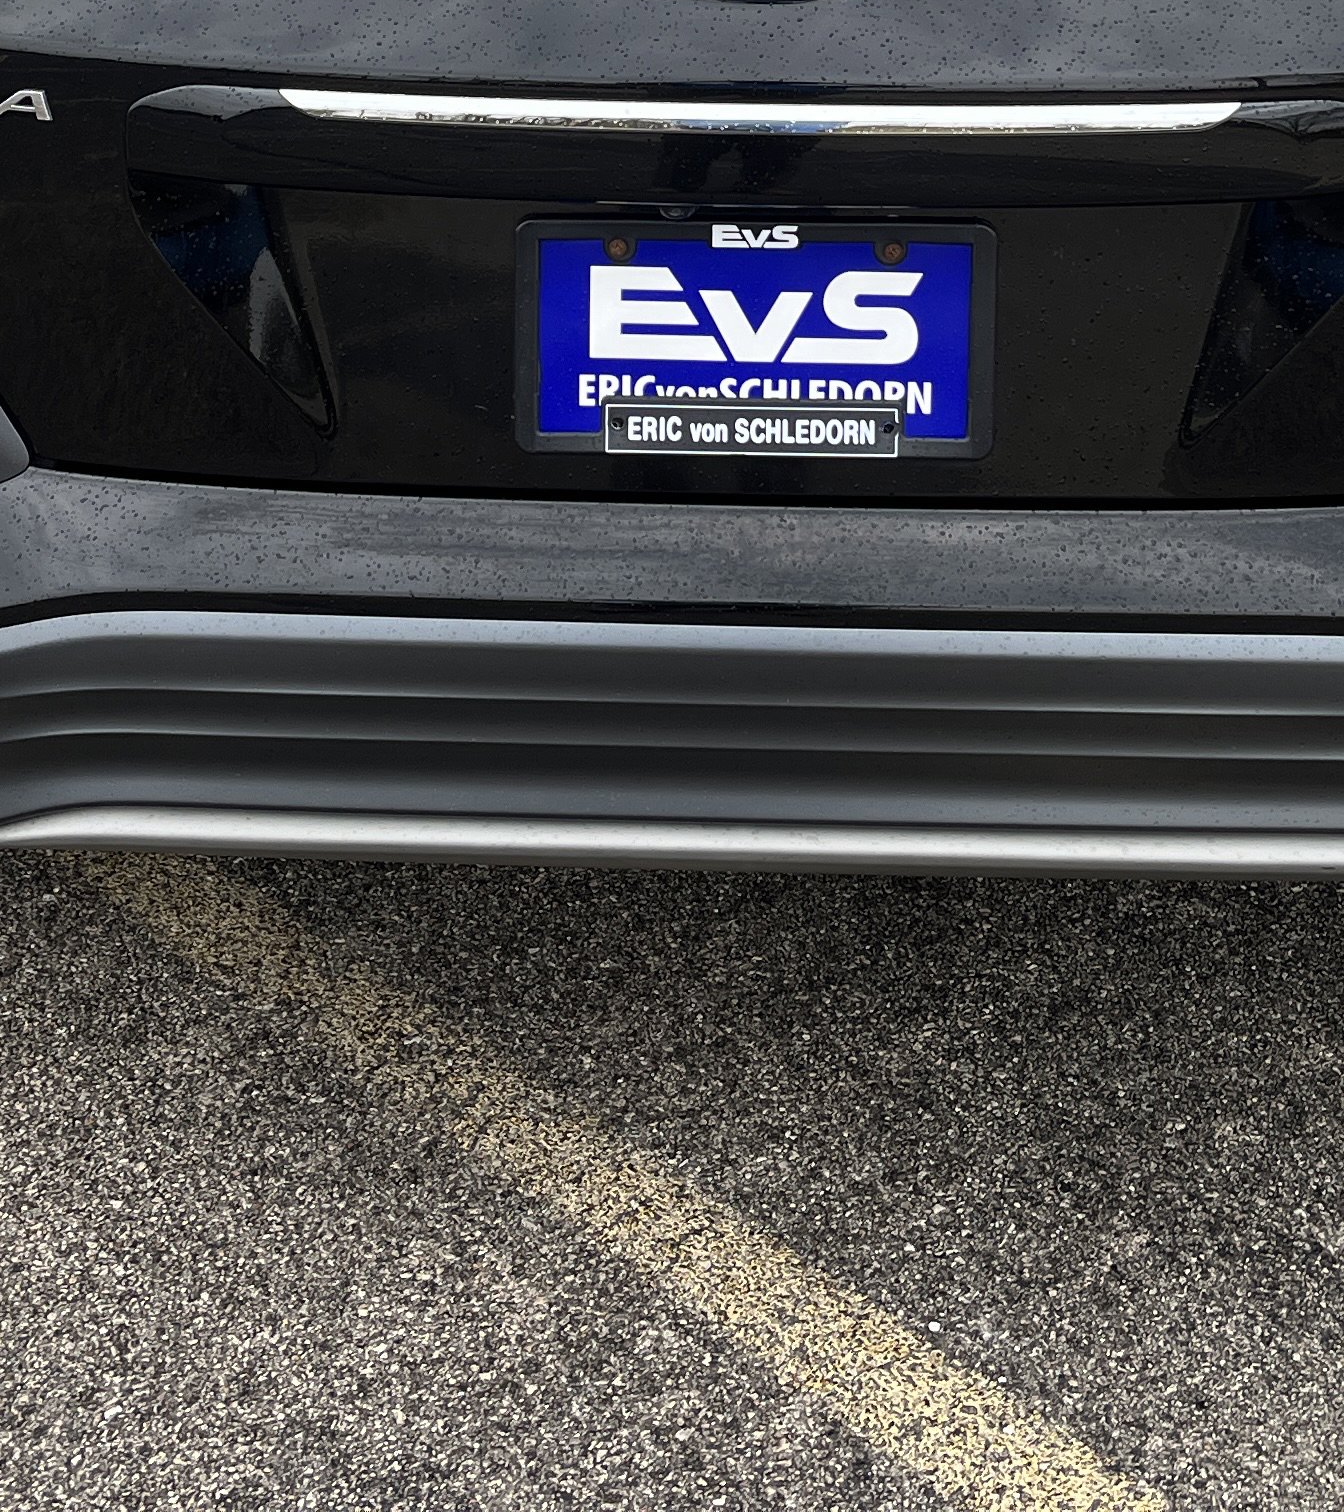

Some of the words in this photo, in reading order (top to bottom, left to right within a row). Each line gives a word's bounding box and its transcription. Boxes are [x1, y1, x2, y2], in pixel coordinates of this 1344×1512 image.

[627, 415, 683, 442] ERIC
[689, 421, 729, 444] von
[734, 417, 876, 446] SCHLEDORN
